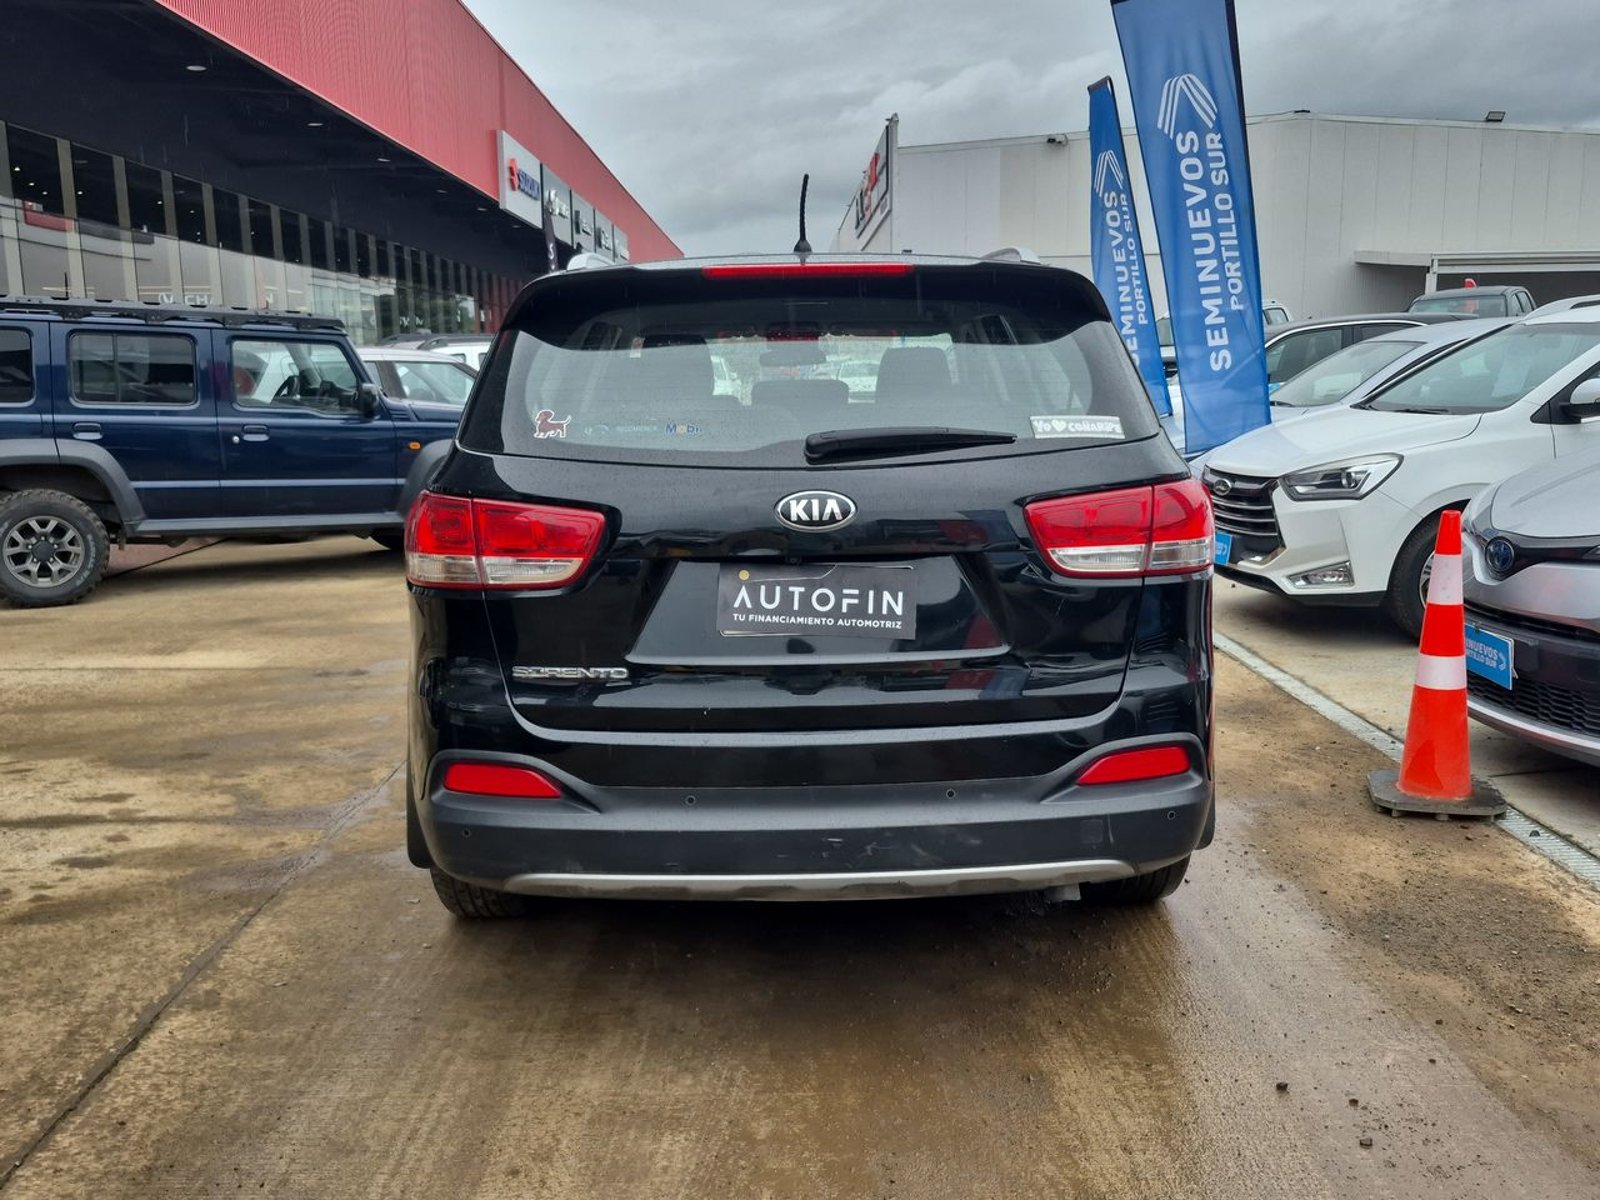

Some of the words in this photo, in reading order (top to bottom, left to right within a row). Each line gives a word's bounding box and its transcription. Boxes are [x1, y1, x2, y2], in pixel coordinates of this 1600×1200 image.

[1205, 132, 1230, 187] SUR
[1120, 194, 1133, 232] SUR
[1176, 130, 1232, 372] SEMINUEVOS
[1213, 193, 1245, 311] PORTILLO
[1127, 238, 1148, 324] PORTILLO
[789, 498, 843, 521] KIA
[733, 585, 904, 615] AUTOFIN
[732, 613, 746, 622] TU
[749, 614, 834, 626] FINANCIAMIENTO
[838, 618, 902, 629] AUTOMOTRIZ
[512, 665, 629, 679] SORENTO
